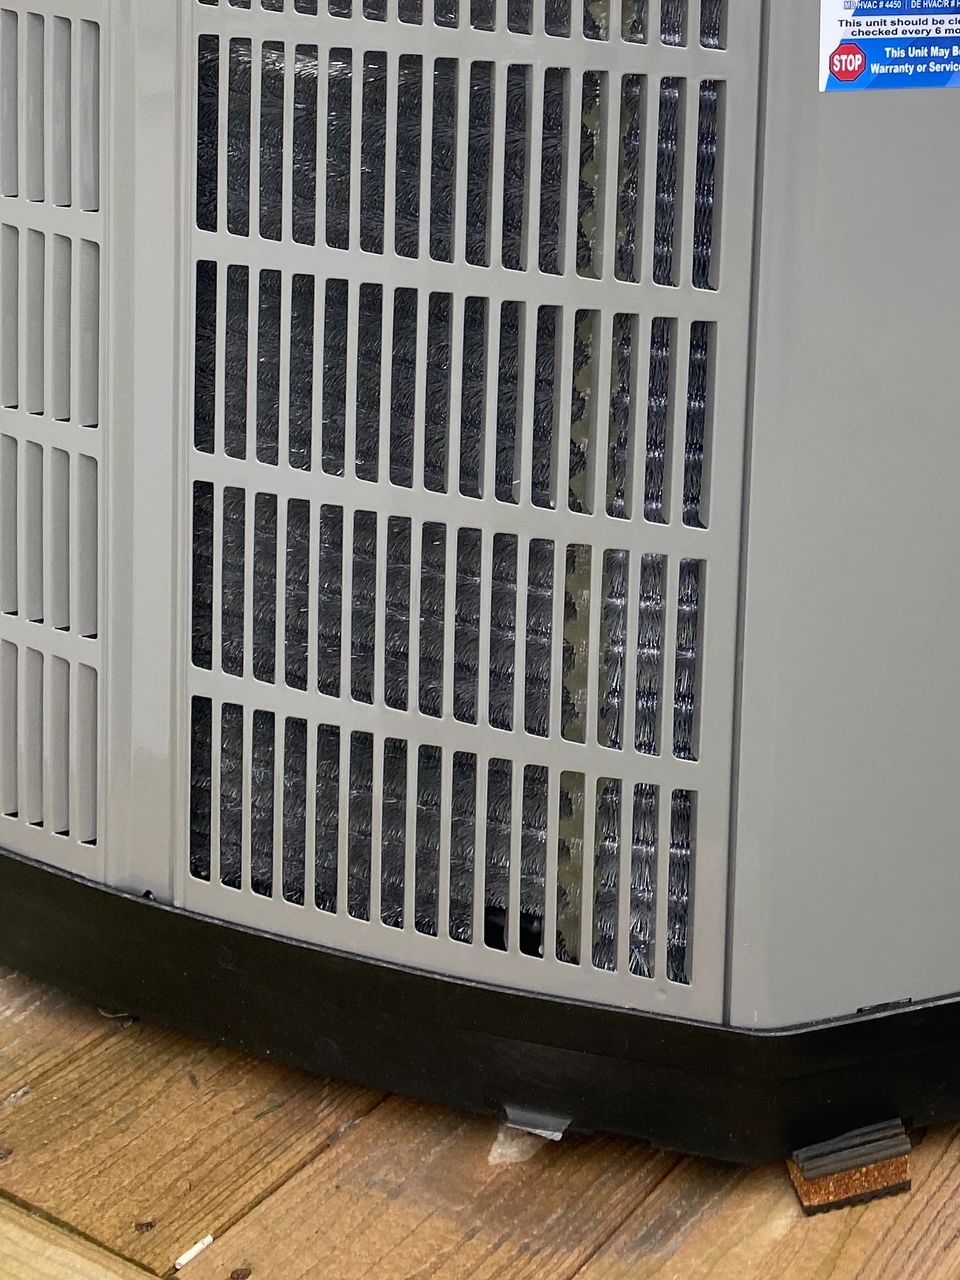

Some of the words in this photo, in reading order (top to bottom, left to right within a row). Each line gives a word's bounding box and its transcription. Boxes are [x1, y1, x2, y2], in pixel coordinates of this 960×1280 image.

[857, 0, 877, 9] HVAC
[884, 0, 902, 9] 4450
[911, 0, 921, 9] DE
[923, 0, 949, 8] HVAC/R
[838, 19, 862, 28] This
[865, 18, 888, 27] unit
[890, 18, 929, 27] should
[931, 17, 945, 26] be
[851, 27, 898, 37] checked
[901, 28, 932, 37] every
[935, 27, 941, 35] 6
[884, 47, 905, 58] This
[908, 46, 928, 57] Unit
[930, 46, 950, 59] May
[833, 54, 863, 72] STOP
[870, 63, 914, 75] Warranty
[916, 64, 927, 72] or
